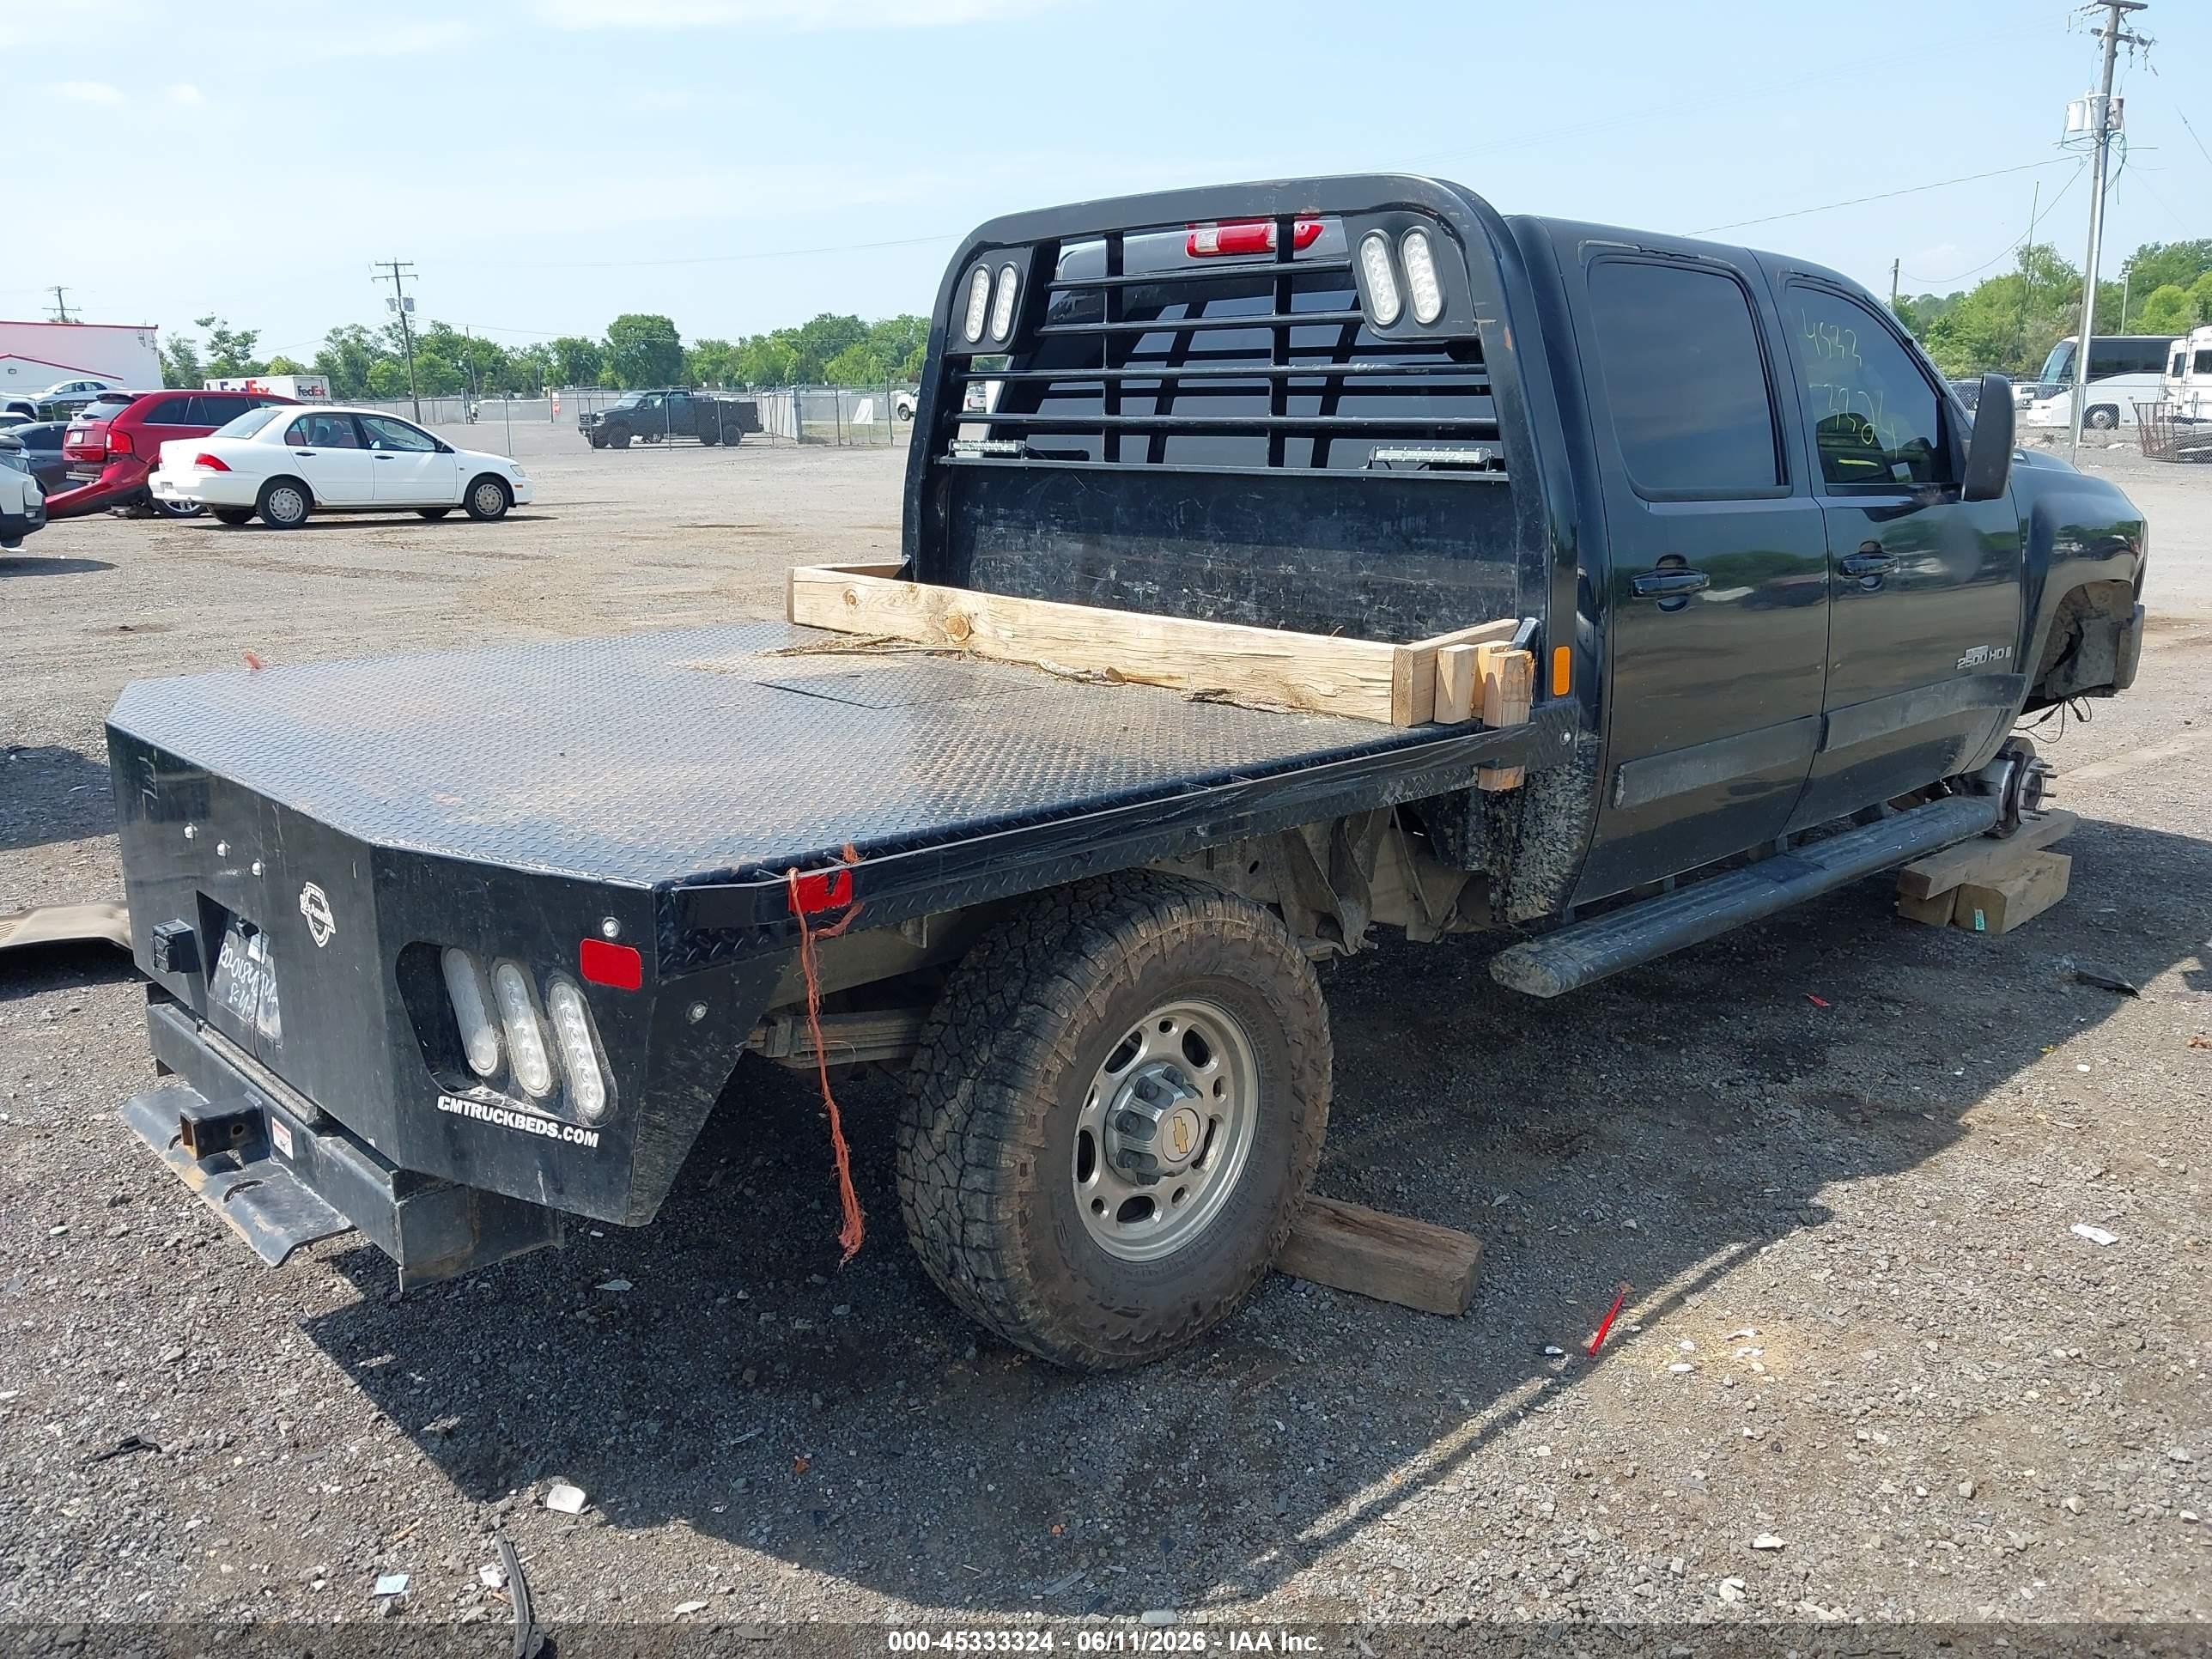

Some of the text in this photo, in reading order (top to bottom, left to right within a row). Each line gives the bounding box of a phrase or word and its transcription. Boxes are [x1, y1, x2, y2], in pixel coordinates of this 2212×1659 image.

[297, 385, 326, 397] FedEx
[1957, 653, 1988, 670] 2500
[1989, 647, 2005, 662] HD
[436, 1094, 600, 1148] CMTRUCKBEDS.COM
